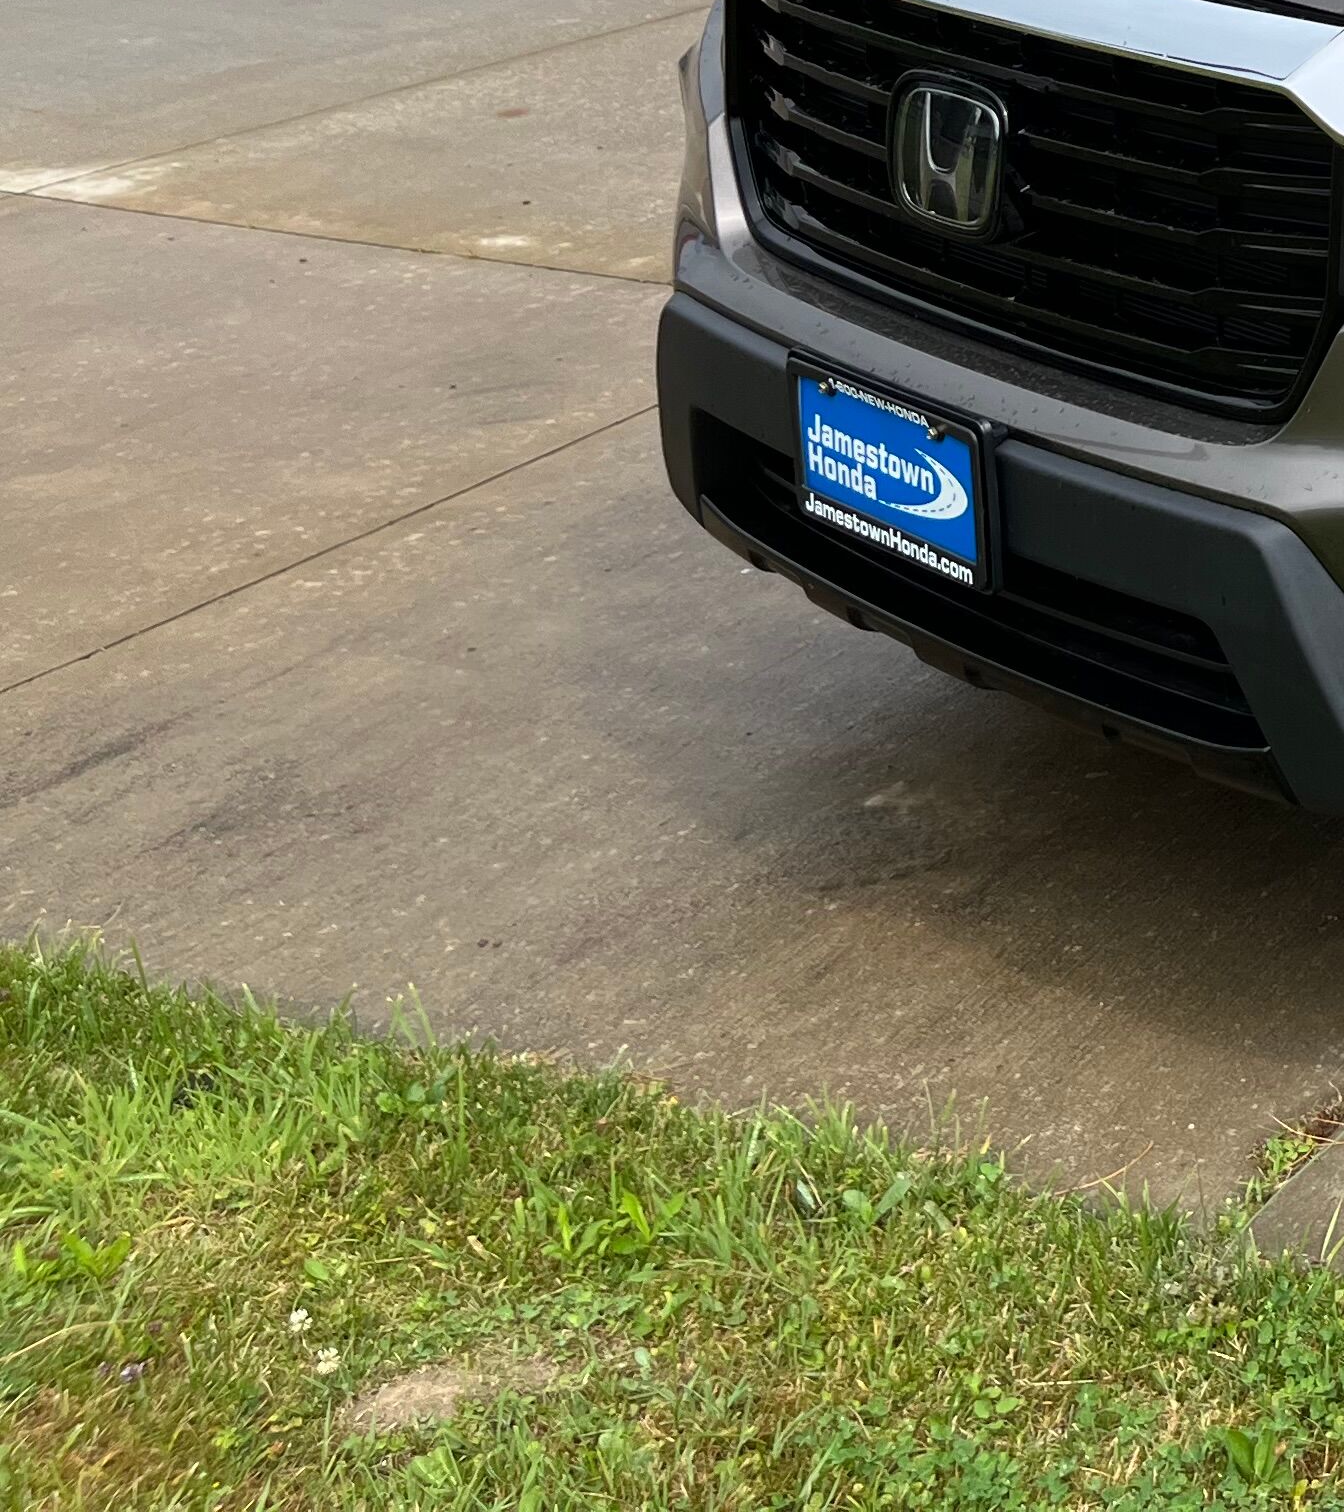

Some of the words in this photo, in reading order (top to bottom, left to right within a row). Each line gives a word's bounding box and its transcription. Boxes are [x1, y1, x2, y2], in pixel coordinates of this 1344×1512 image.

[827, 377, 930, 429] 1-800-NEW-HONDA
[807, 413, 935, 495] Jamestown
[807, 441, 878, 501] Honda
[805, 492, 974, 585] JamestownHonda.com
